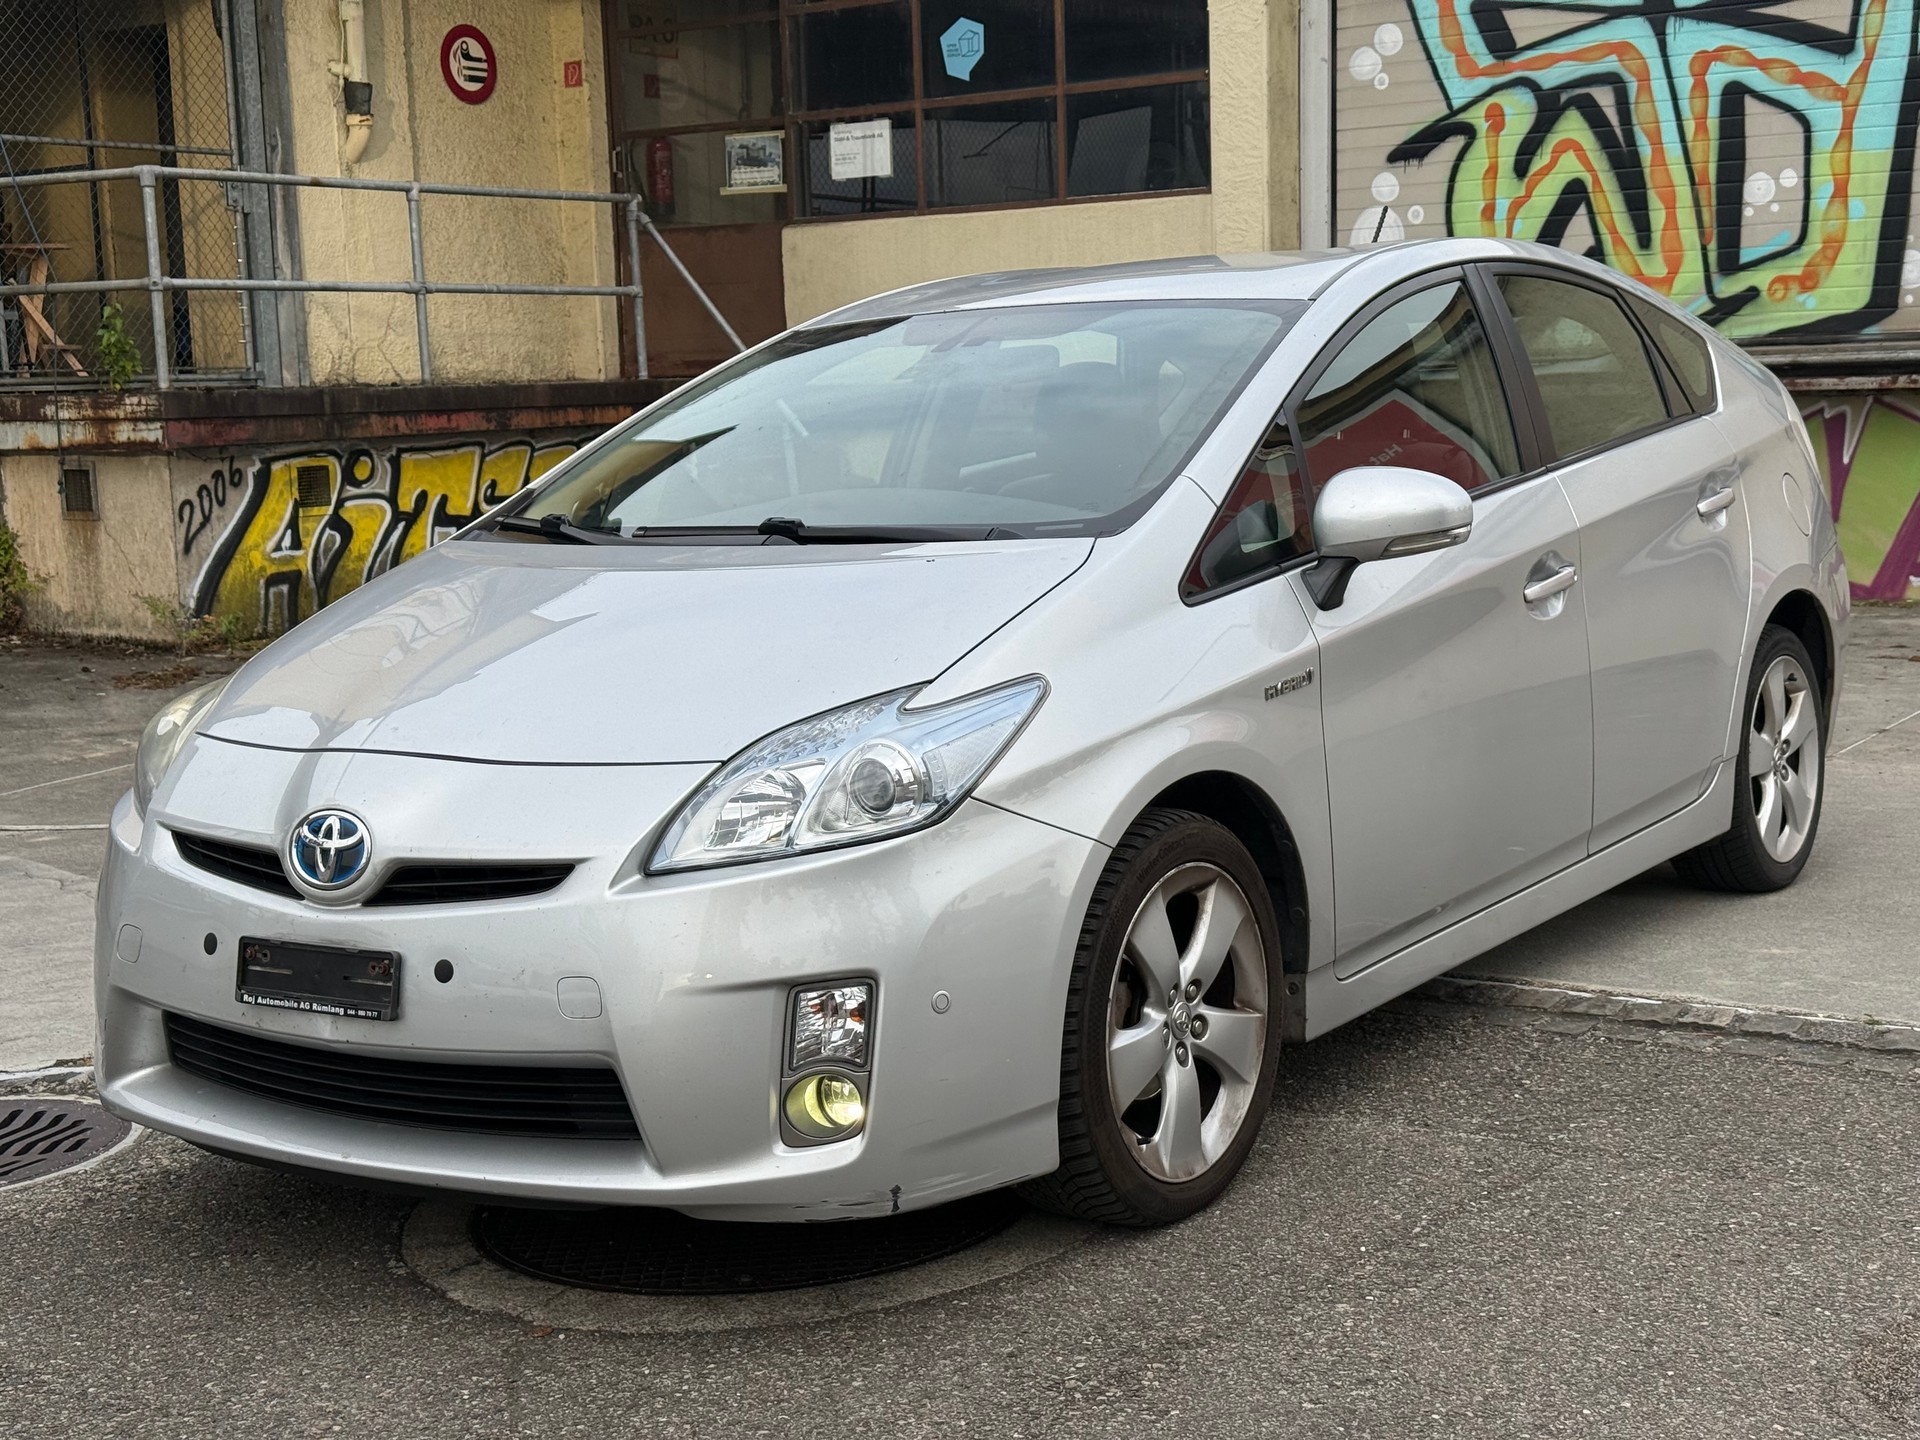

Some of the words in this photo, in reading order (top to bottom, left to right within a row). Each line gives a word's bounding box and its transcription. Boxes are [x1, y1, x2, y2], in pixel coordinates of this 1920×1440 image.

[1264, 667, 1314, 702] HYBRID
[243, 994, 255, 1005] Roj
[257, 996, 298, 1008] Automobile
[299, 1001, 310, 1010] AG
